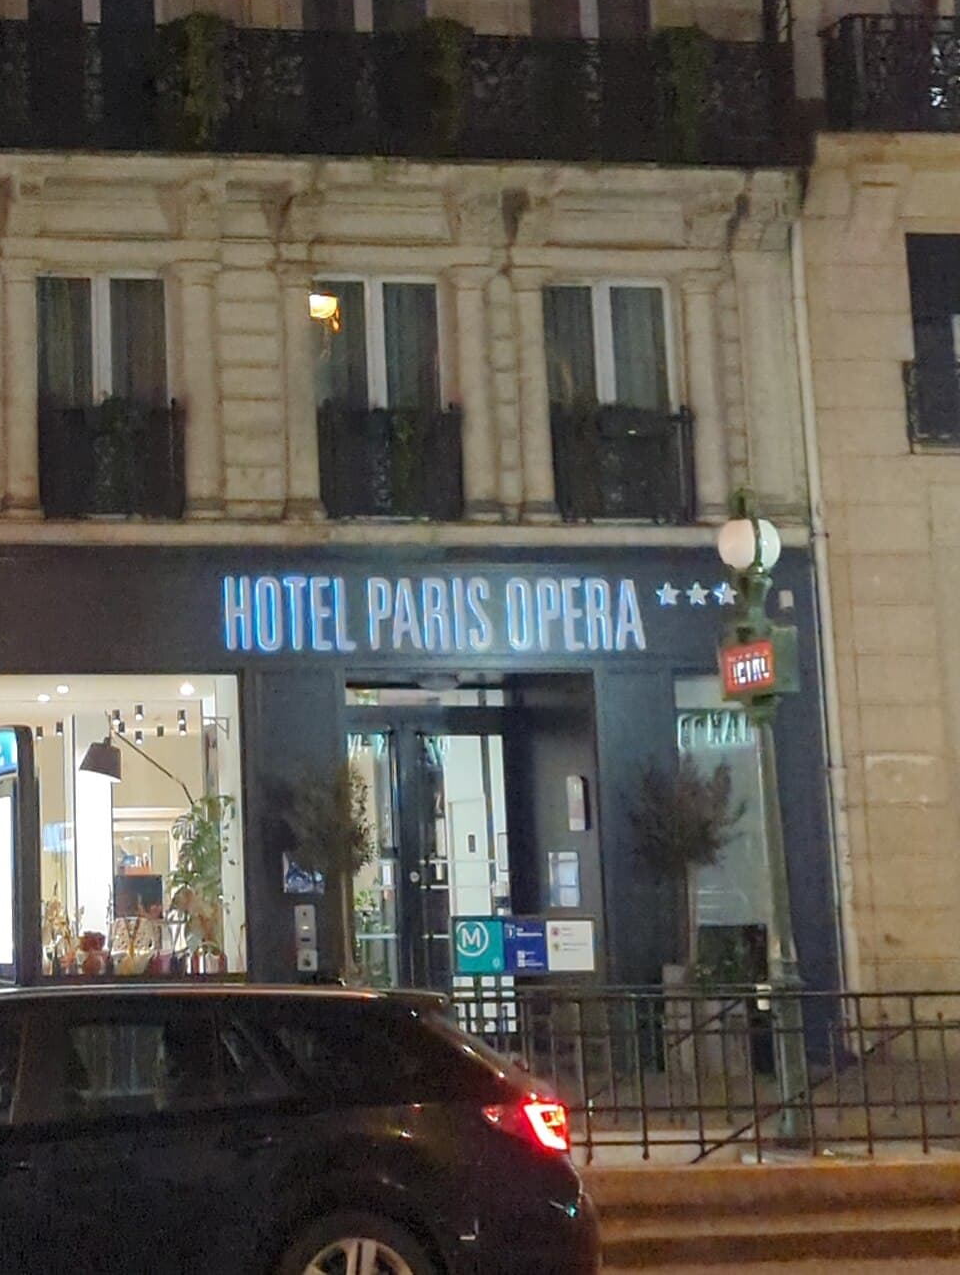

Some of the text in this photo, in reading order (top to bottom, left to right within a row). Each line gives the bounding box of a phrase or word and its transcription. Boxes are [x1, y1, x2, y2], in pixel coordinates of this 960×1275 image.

[223, 575, 646, 652] HOTEL PARIS OPERA
[461, 927, 481, 949] M
